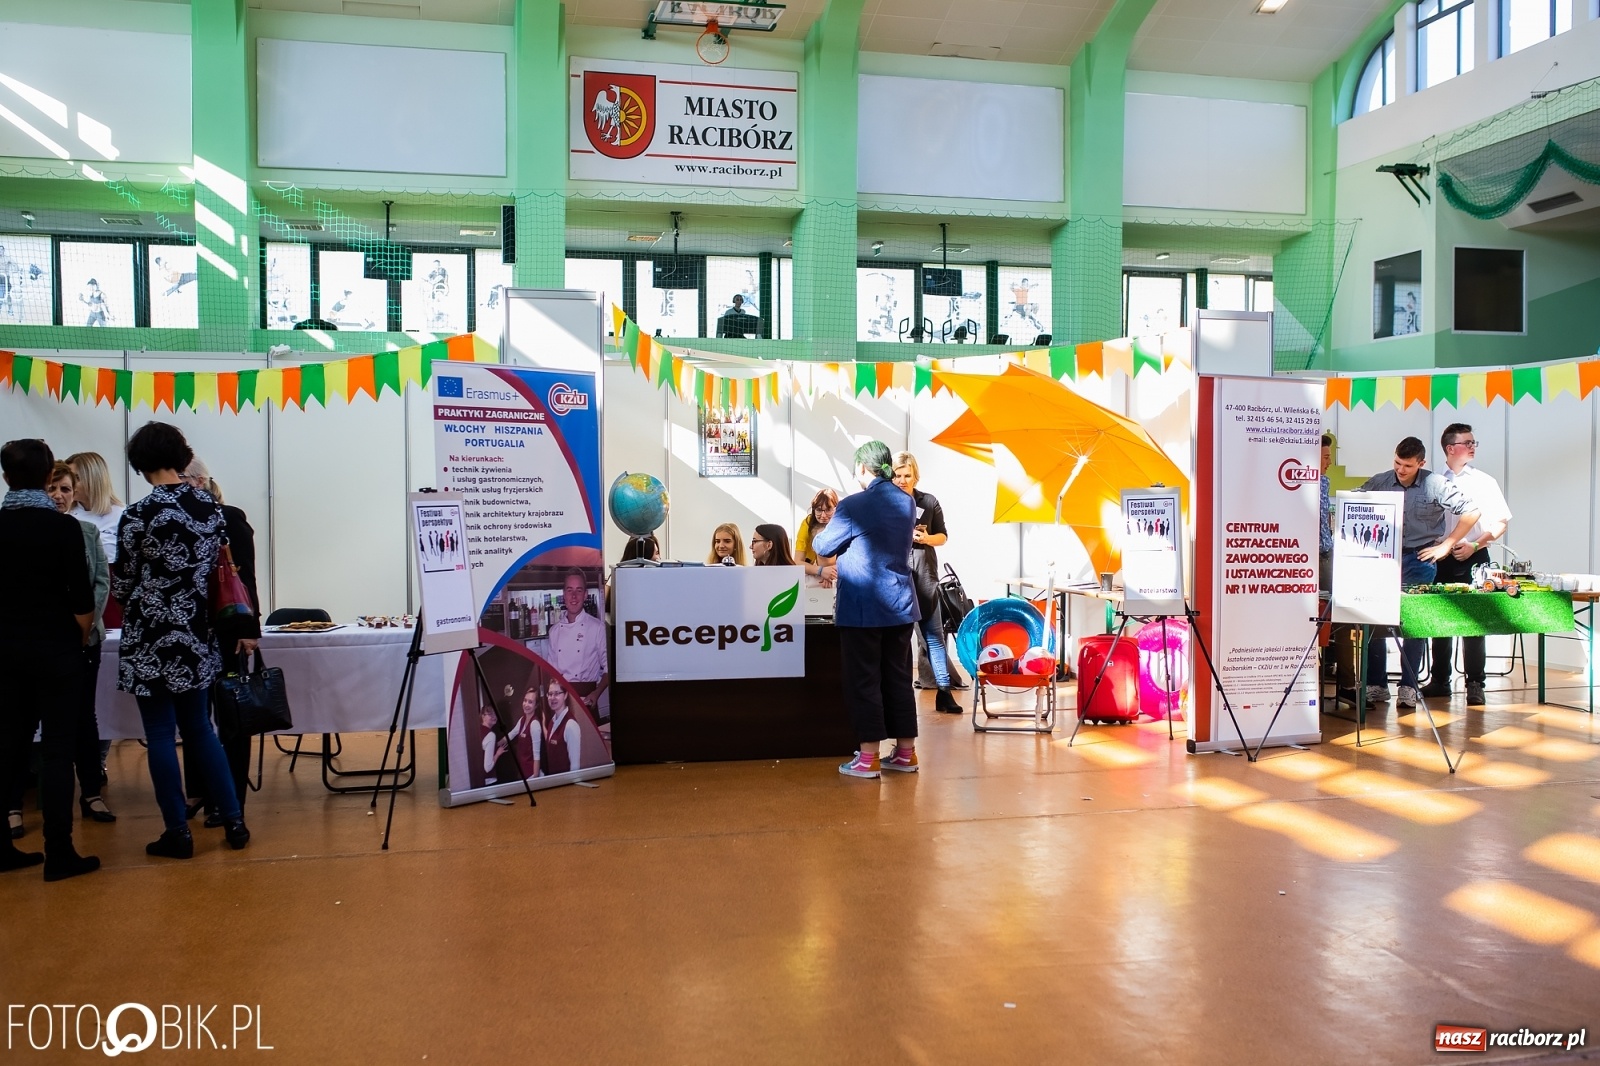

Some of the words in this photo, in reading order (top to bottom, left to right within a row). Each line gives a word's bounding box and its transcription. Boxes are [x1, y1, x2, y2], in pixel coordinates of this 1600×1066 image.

[683, 95, 778, 121] MIASTO
[668, 123, 793, 151] RACIBÓRZ
[674, 164, 782, 179] www.raciborz.pl
[466, 387, 520, 401] Erasmus+
[1225, 404, 1246, 412] 47-400
[1247, 405, 1274, 414] Racibórz,
[1283, 406, 1310, 414] Wileńska
[438, 408, 484, 418] PRAKTYKI
[485, 410, 545, 421] ZAGRANICZNE
[444, 424, 486, 433] WŁOCHY
[494, 426, 543, 435] HISZPANIA
[465, 438, 525, 448] PORTUGALIA
[481, 466, 512, 475] żywienia
[457, 476, 477, 485] usług
[478, 476, 544, 485] gastronomicznych,
[482, 486, 502, 495] usług
[502, 486, 544, 495] fryzjerskich
[482, 498, 532, 507] budownictwa,
[420, 509, 443, 518] Festiwal
[482, 510, 526, 519] architektury
[527, 509, 564, 518] krajobrazu
[1130, 508, 1166, 516] perspektyw
[1347, 505, 1374, 513] Festiwal
[1347, 513, 1385, 521] perspektyw
[421, 518, 453, 528] perspektyw
[483, 523, 512, 531] ochrony
[514, 521, 552, 530] środowiska
[1225, 522, 1279, 533] CENTRUM
[483, 535, 528, 543] hotelarstwa,
[1225, 538, 1300, 548] KSZTAŁCENIA
[484, 547, 513, 556] analityk
[1225, 553, 1309, 563] ZAWODOWEGO
[1225, 569, 1229, 579] I
[1230, 569, 1314, 579] USTAWICZNEGO
[1225, 584, 1239, 594] NR
[1242, 584, 1246, 594] 1
[1248, 584, 1259, 594] W
[1261, 583, 1317, 594] RACIBORZU
[436, 614, 472, 628] gastronomia
